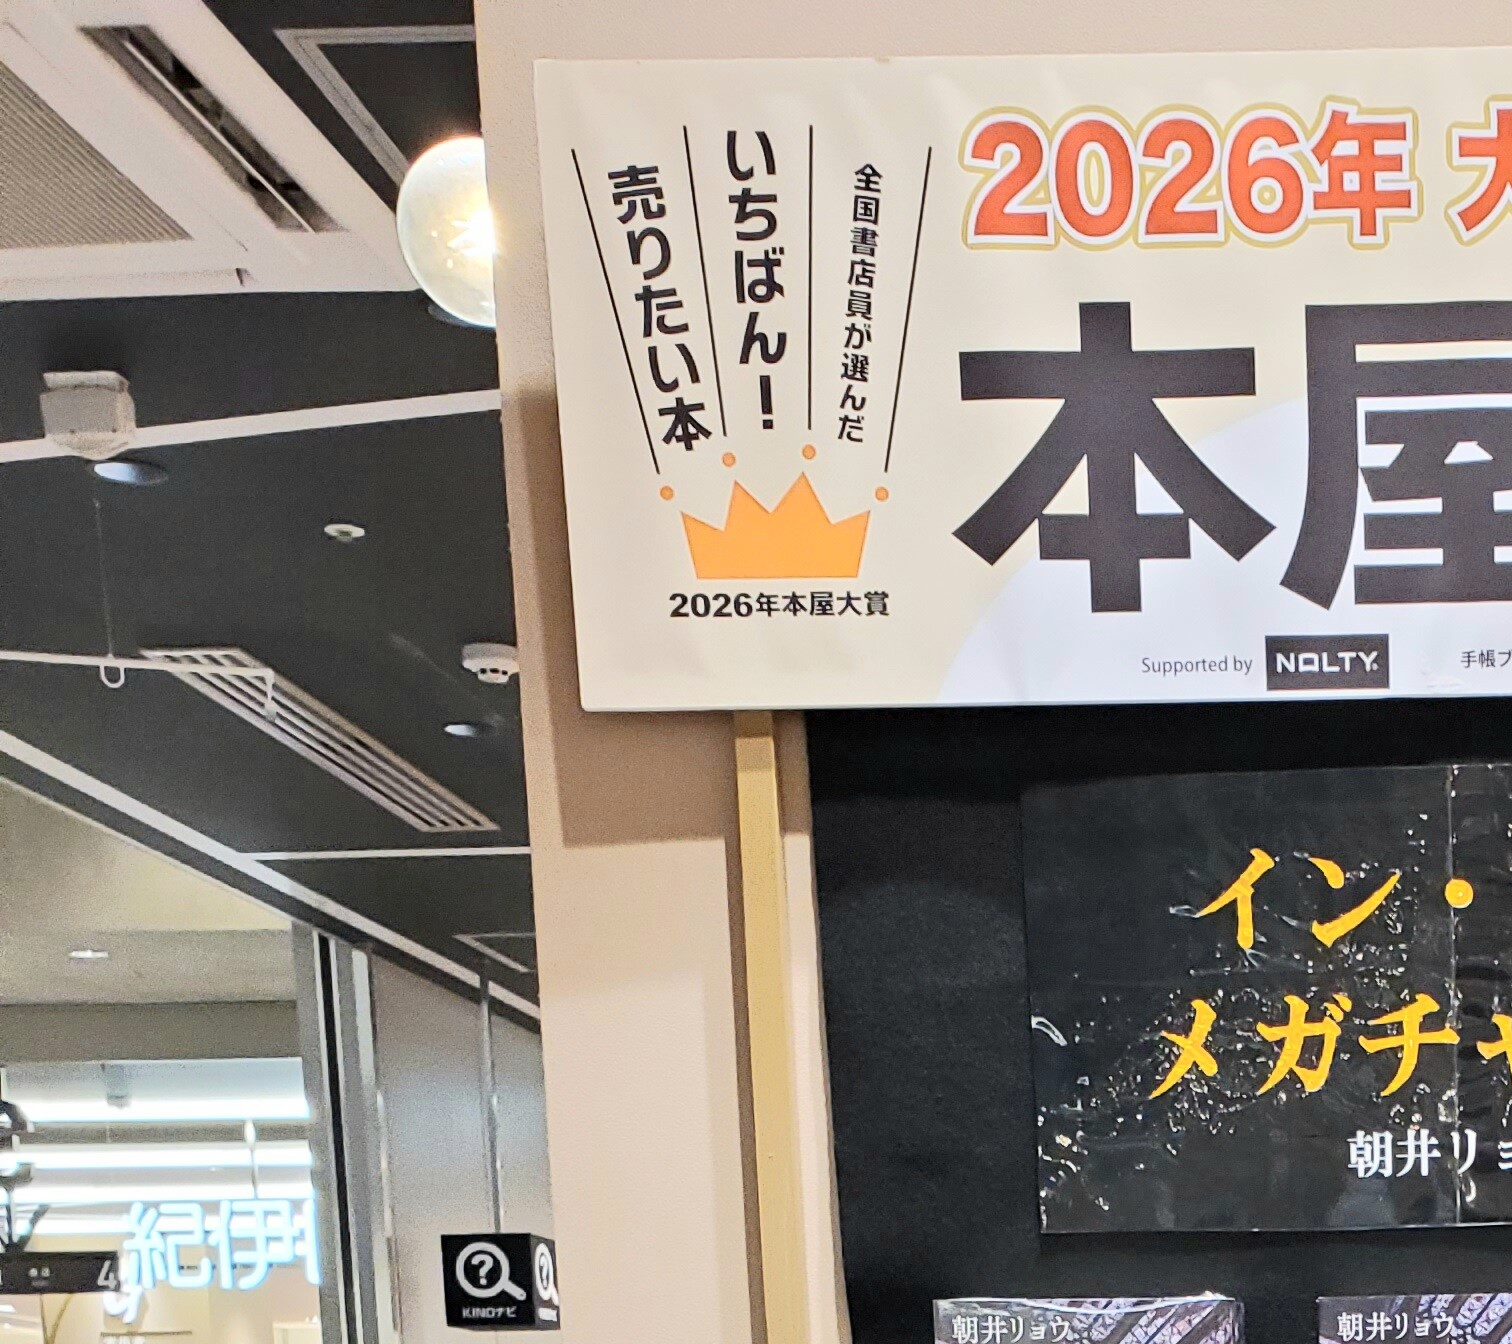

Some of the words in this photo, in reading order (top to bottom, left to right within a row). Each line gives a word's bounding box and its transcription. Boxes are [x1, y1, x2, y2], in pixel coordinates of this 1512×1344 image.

[962, 100, 1418, 248] 2026年
[608, 165, 712, 451] 売りたい本
[724, 129, 787, 430] いちばん!
[838, 164, 883, 443] 全国書店員が選んだ
[669, 591, 890, 619] 2026年本屋大賞
[1141, 654, 1228, 677] Supported
[1233, 655, 1252, 679] by
[124, 1199, 321, 1290] 紀伊
[462, 1306, 516, 1318] KINOナビ
[952, 1314, 1070, 1344] 朝井リョウ
[1337, 1312, 1454, 1341] 朝井リョウ
